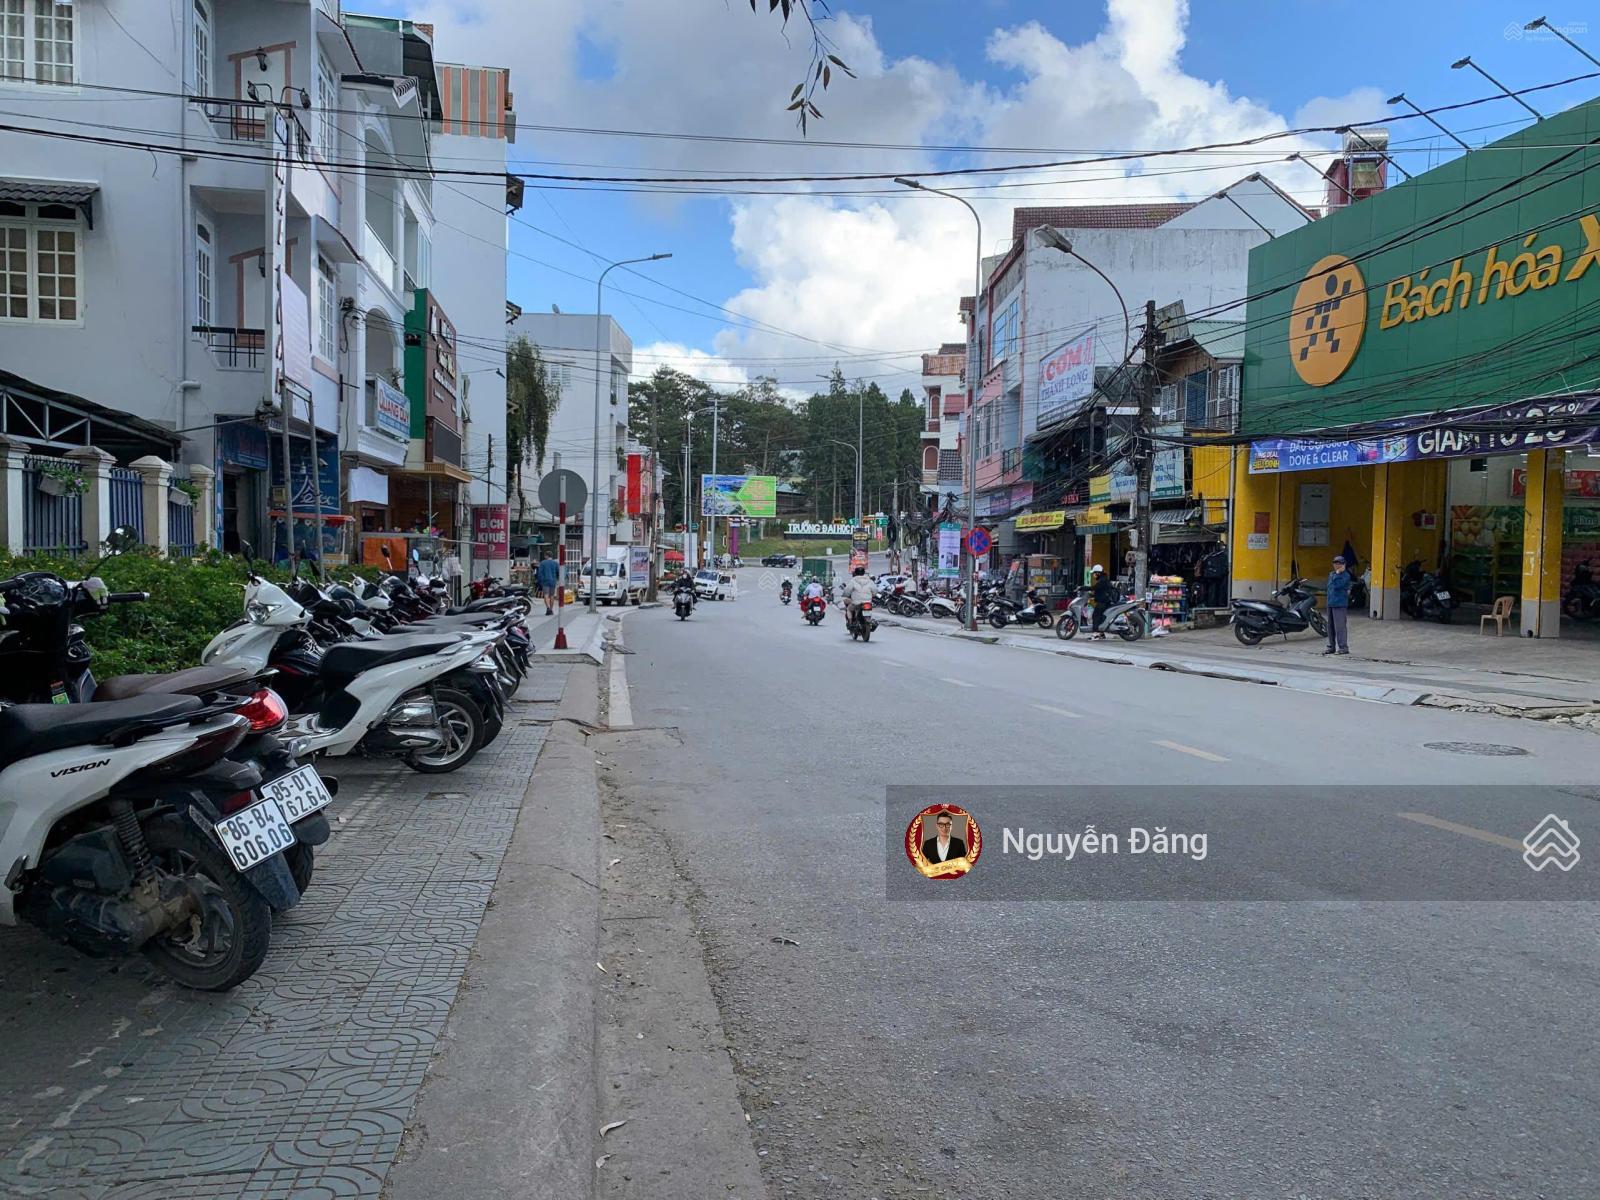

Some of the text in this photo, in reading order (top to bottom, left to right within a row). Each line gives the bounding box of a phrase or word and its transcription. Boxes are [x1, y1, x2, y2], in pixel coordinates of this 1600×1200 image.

[1379, 257, 1473, 330] Bách
[1477, 233, 1564, 305] hóa
[1066, 368, 1088, 390] LONG
[1289, 454, 1311, 469] DOVE
[1320, 450, 1349, 464] CLEAR
[51, 758, 111, 778] VISION
[271, 771, 312, 802] 85-D1
[226, 803, 275, 842] 86-B4
[232, 823, 293, 867] 606.06
